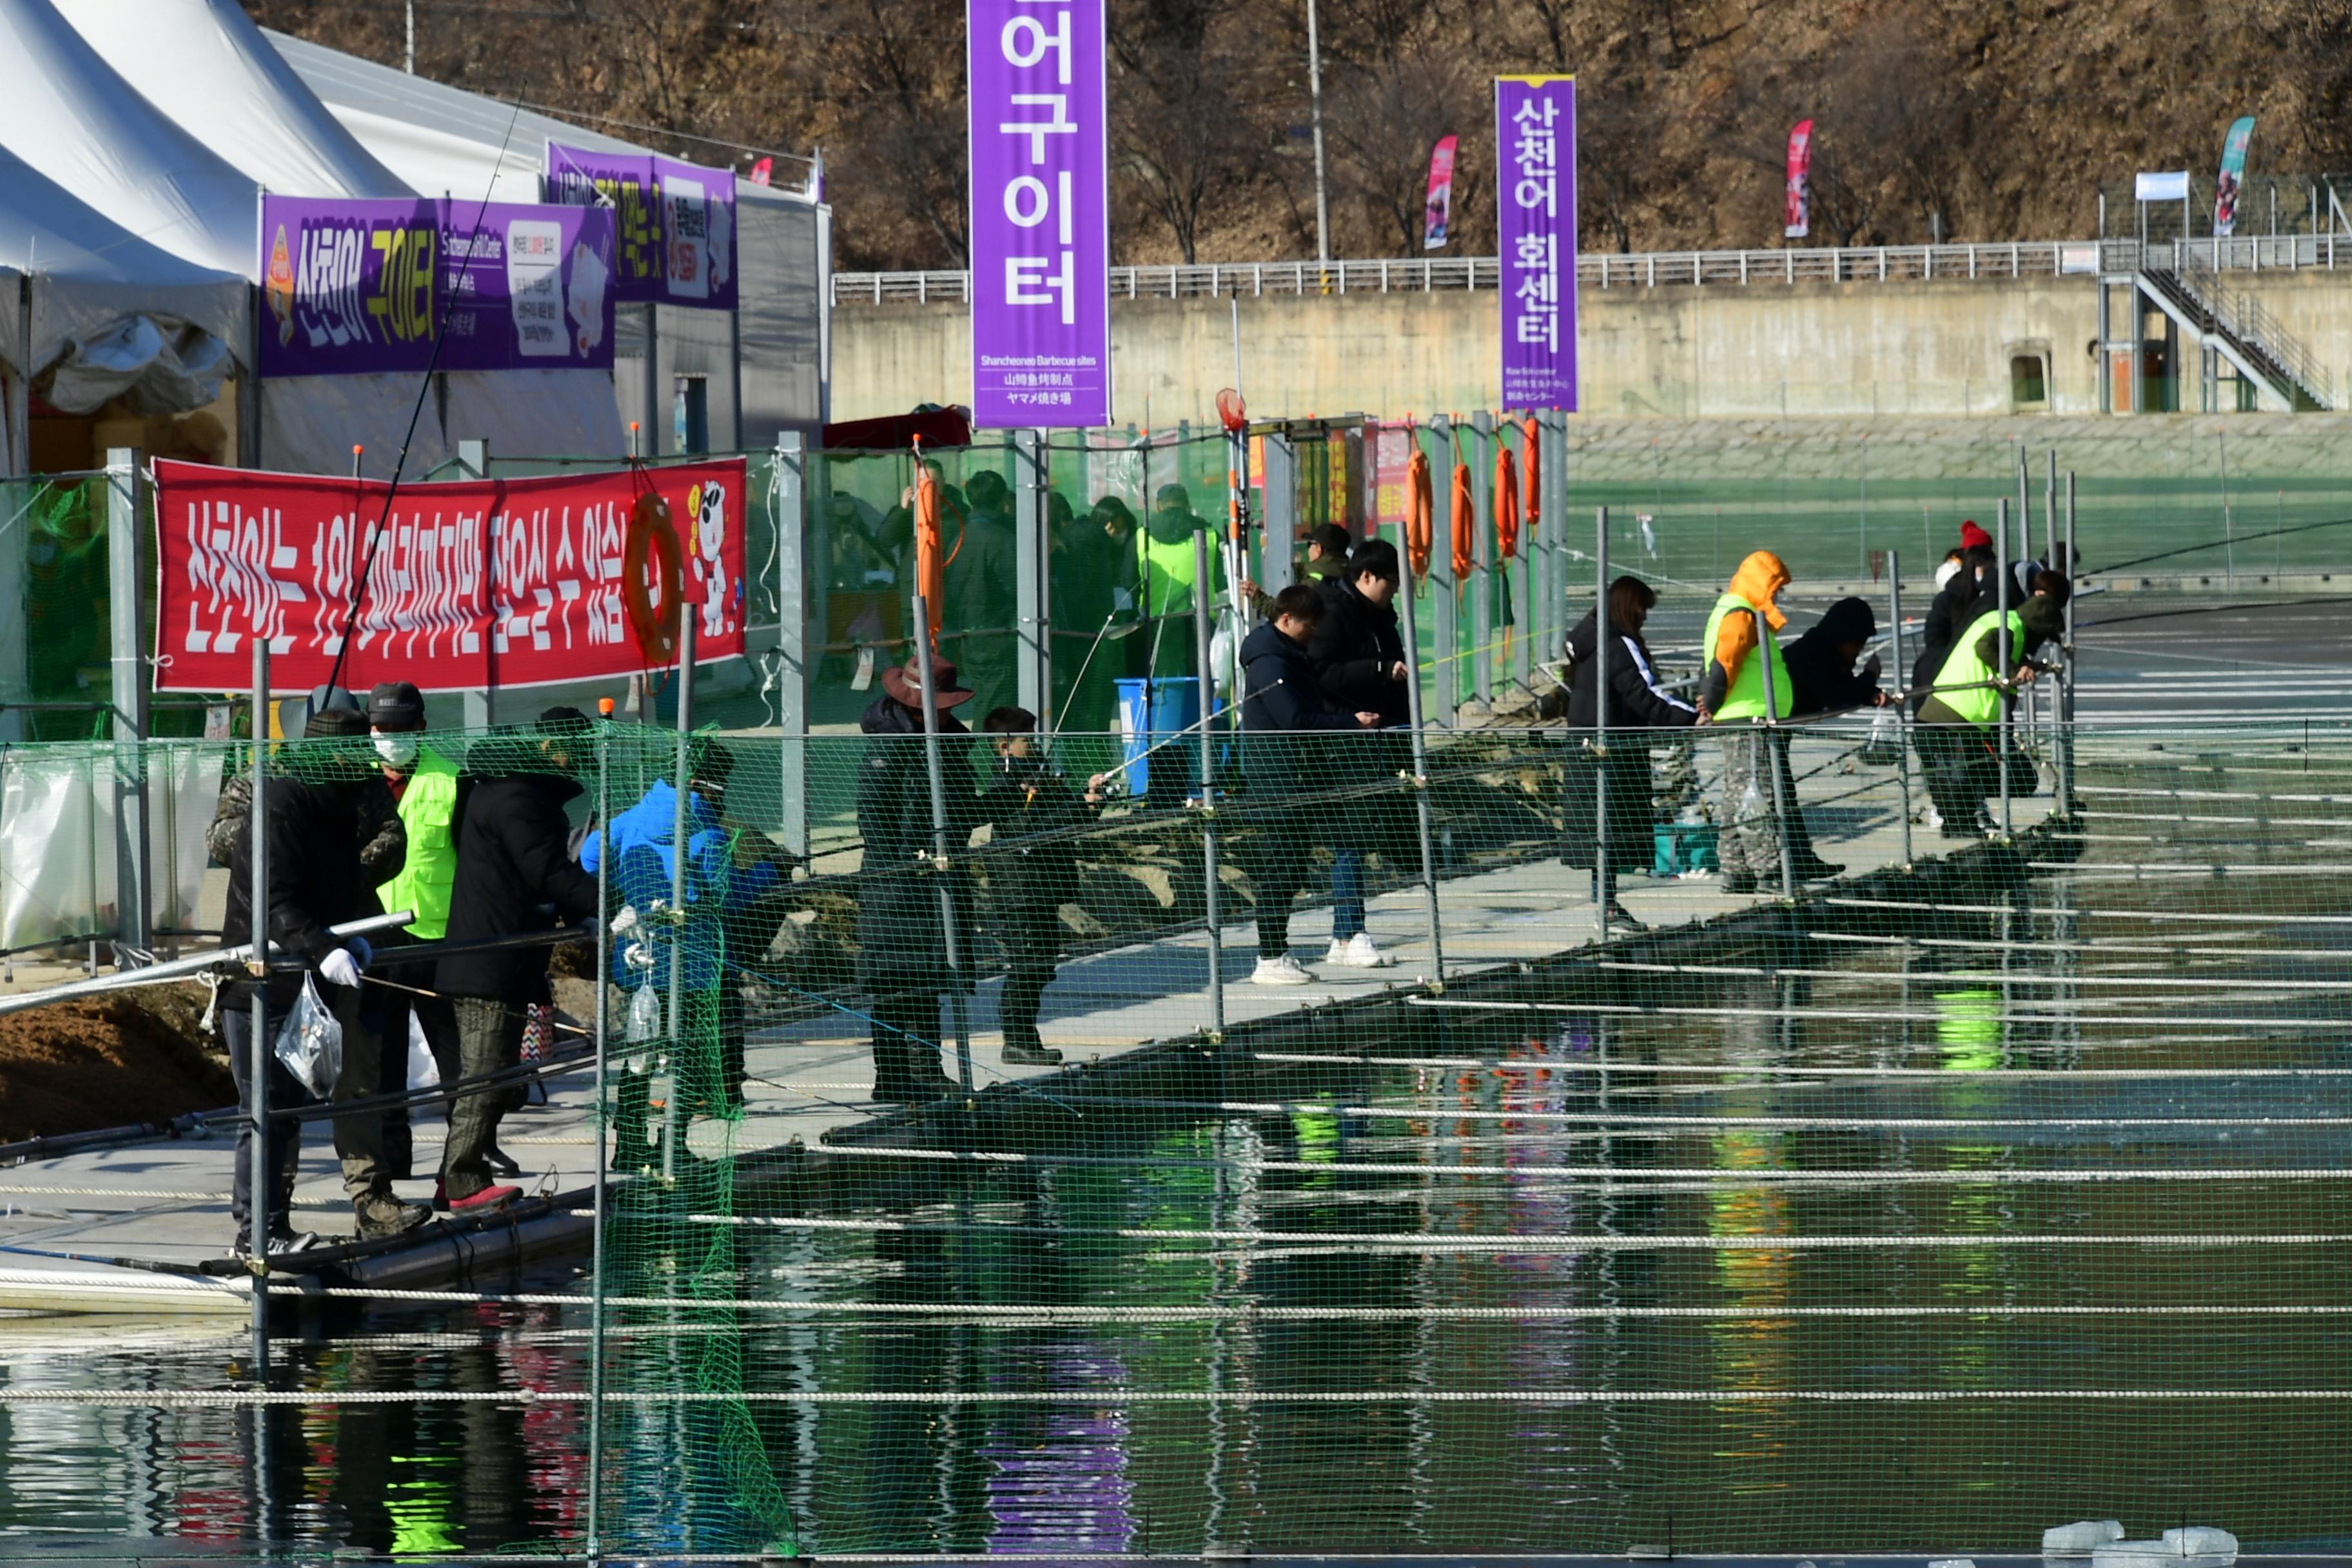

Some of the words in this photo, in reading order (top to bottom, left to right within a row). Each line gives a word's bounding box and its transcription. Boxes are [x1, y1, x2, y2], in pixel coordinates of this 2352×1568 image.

[999, 0, 1078, 324] 어구이터
[1513, 97, 1560, 217] 산천어
[296, 228, 373, 347] 산천어
[366, 228, 435, 345] 구이터
[1513, 232, 1558, 353] 회센터
[1036, 355, 1076, 366] Barbecue
[185, 500, 306, 655] 산천어는
[491, 506, 550, 654] 잡으실
[556, 505, 582, 650] 수
